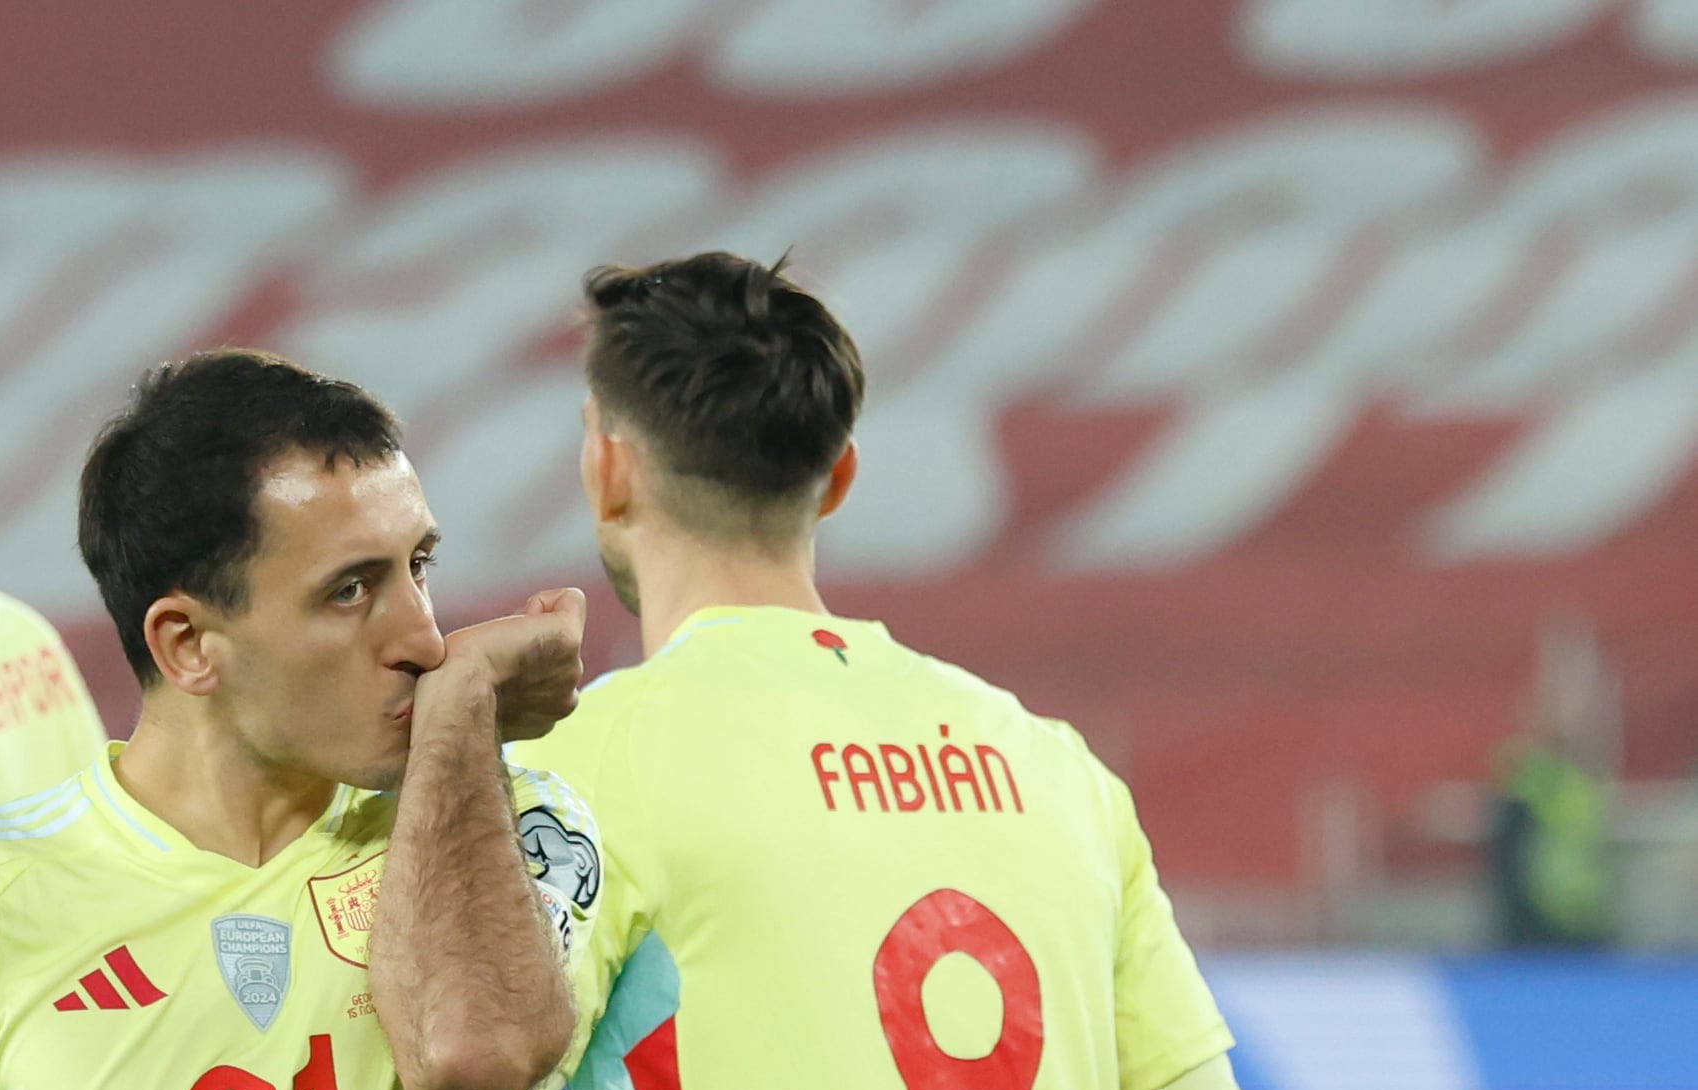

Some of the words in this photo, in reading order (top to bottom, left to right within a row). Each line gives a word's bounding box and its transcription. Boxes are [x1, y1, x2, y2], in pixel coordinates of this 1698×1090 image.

[810, 723, 1025, 814] FABIÁN
[220, 929, 286, 943] EUROPEAN
[220, 941, 288, 954] CHAMPIONS
[243, 991, 277, 1004] 2024
